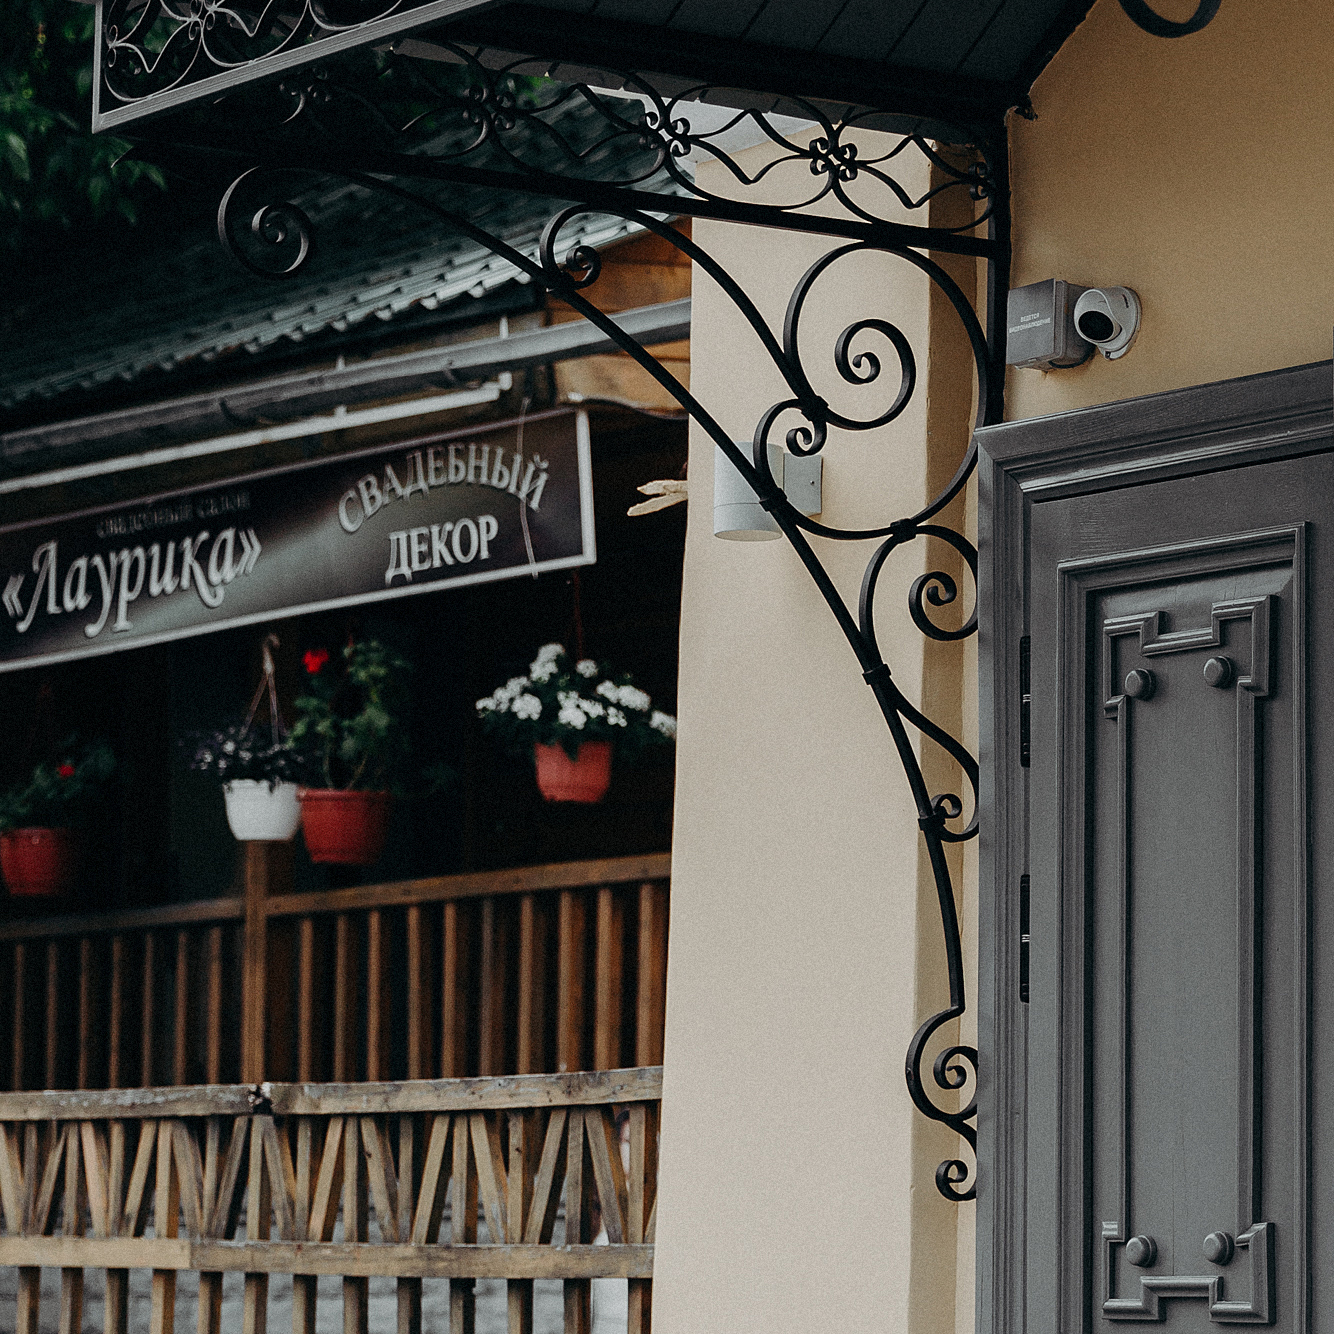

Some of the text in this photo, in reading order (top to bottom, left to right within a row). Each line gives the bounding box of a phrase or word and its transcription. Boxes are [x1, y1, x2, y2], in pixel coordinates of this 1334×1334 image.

[337, 441, 550, 534] СВАДЕБНЫЙ
[2, 526, 262, 638] «Лаурика»
[385, 514, 499, 585] ДЕКОР
